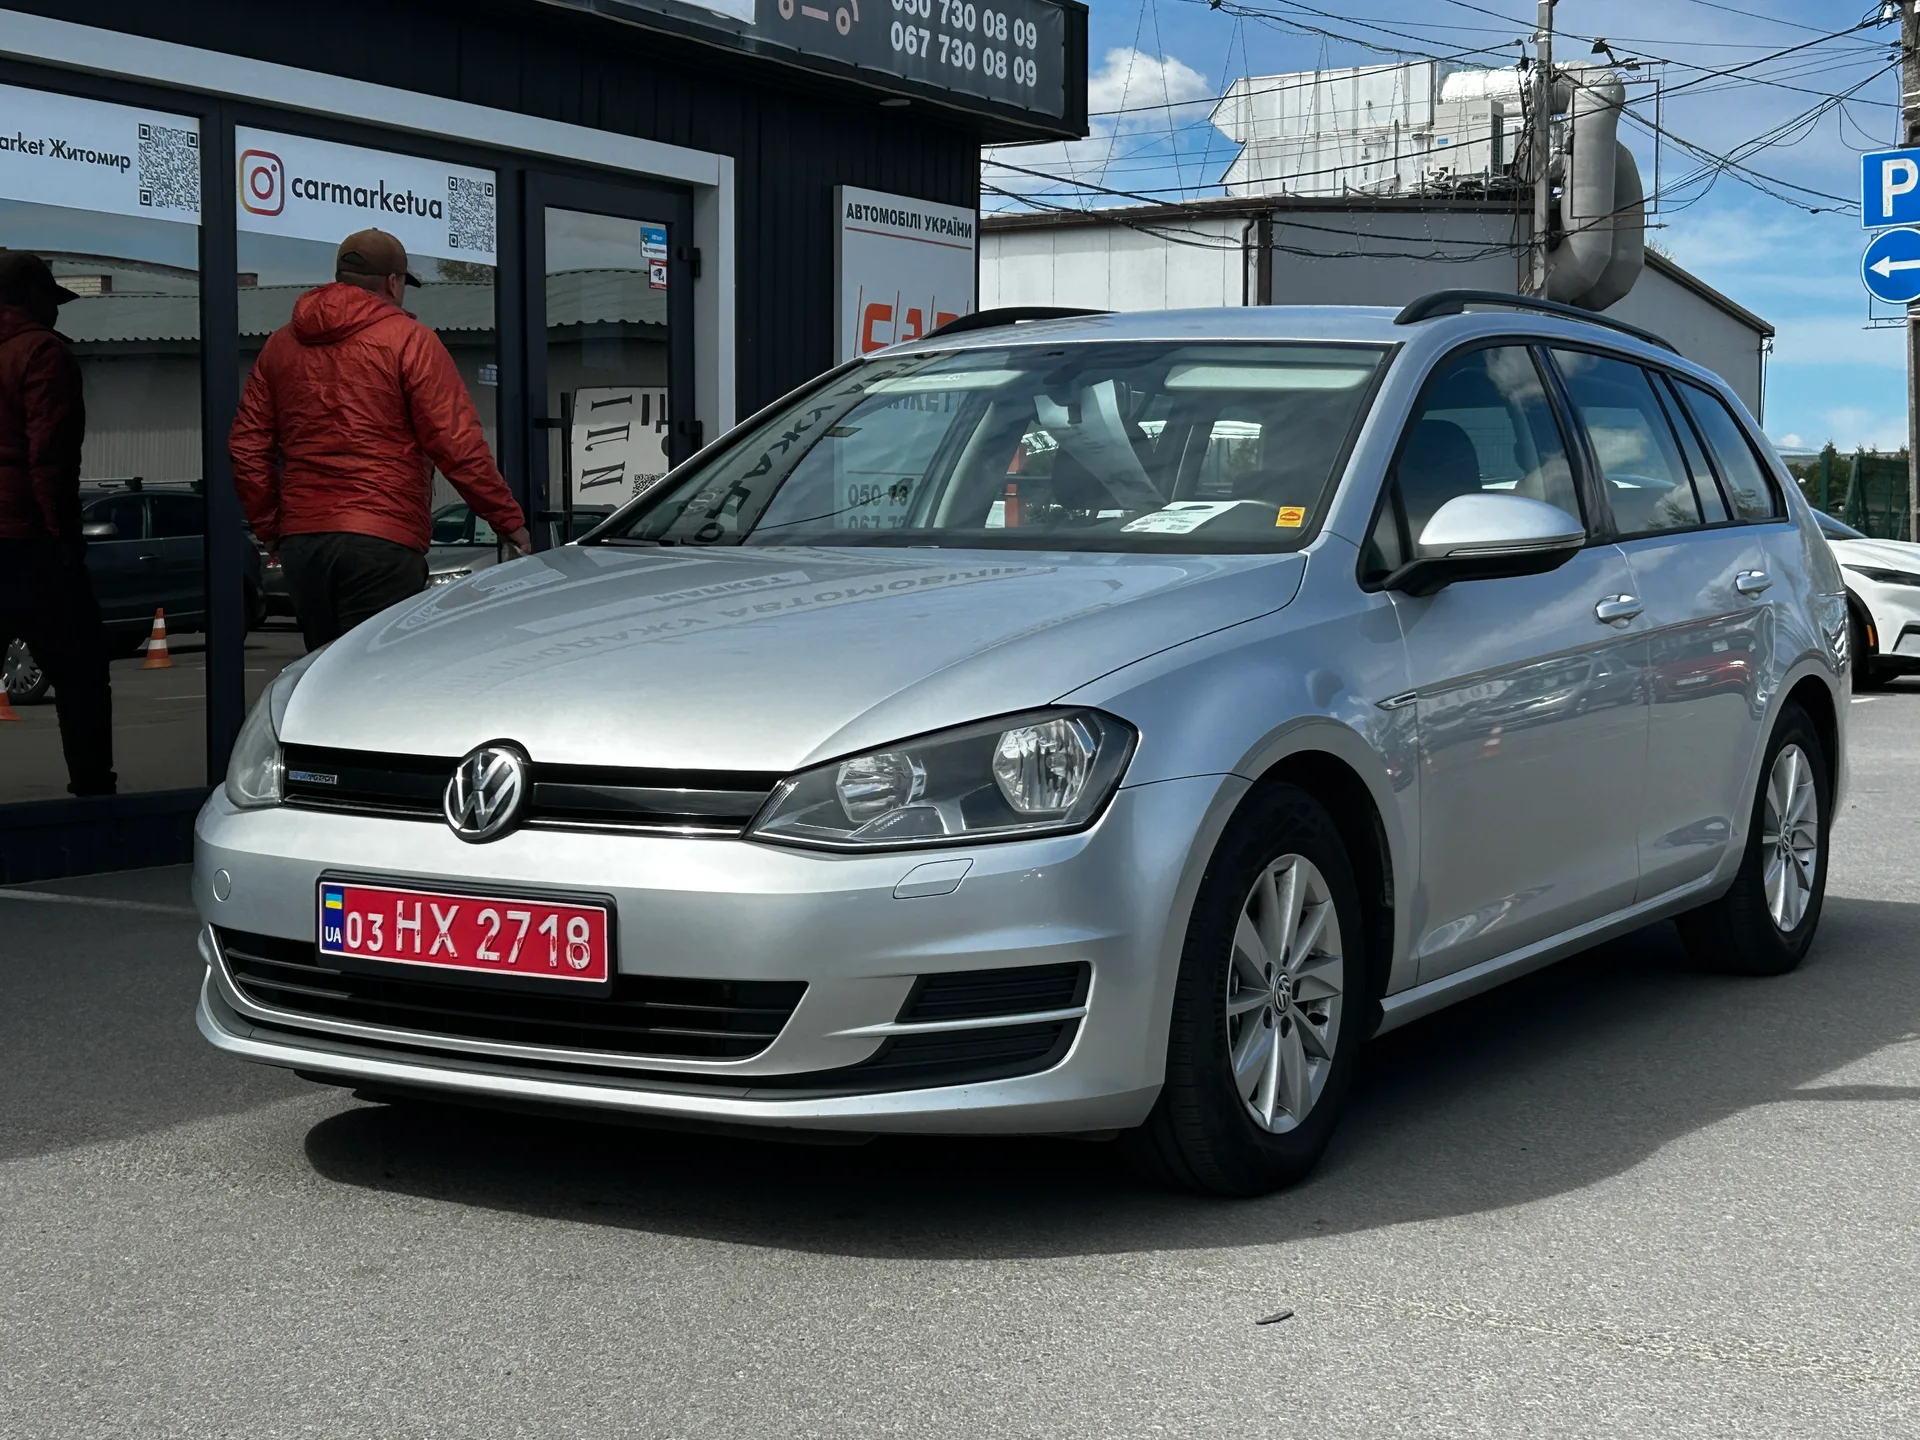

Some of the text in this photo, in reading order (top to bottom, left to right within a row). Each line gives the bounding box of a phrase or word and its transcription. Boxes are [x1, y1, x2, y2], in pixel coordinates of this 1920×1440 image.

[938, 0, 976, 32] 730
[983, 9, 1008, 41] 08
[1013, 18, 1037, 50] 09
[890, 21, 1037, 88] 067 730 08 09
[48, 137, 131, 174] Житомир
[291, 176, 443, 220] carmarketua
[1882, 158, 1919, 217] P
[845, 202, 972, 239] АВТОМОБІЛІ УКРАЇНИ
[325, 926, 342, 945] UA
[346, 911, 383, 952] 03
[475, 908, 591, 970] 2718
